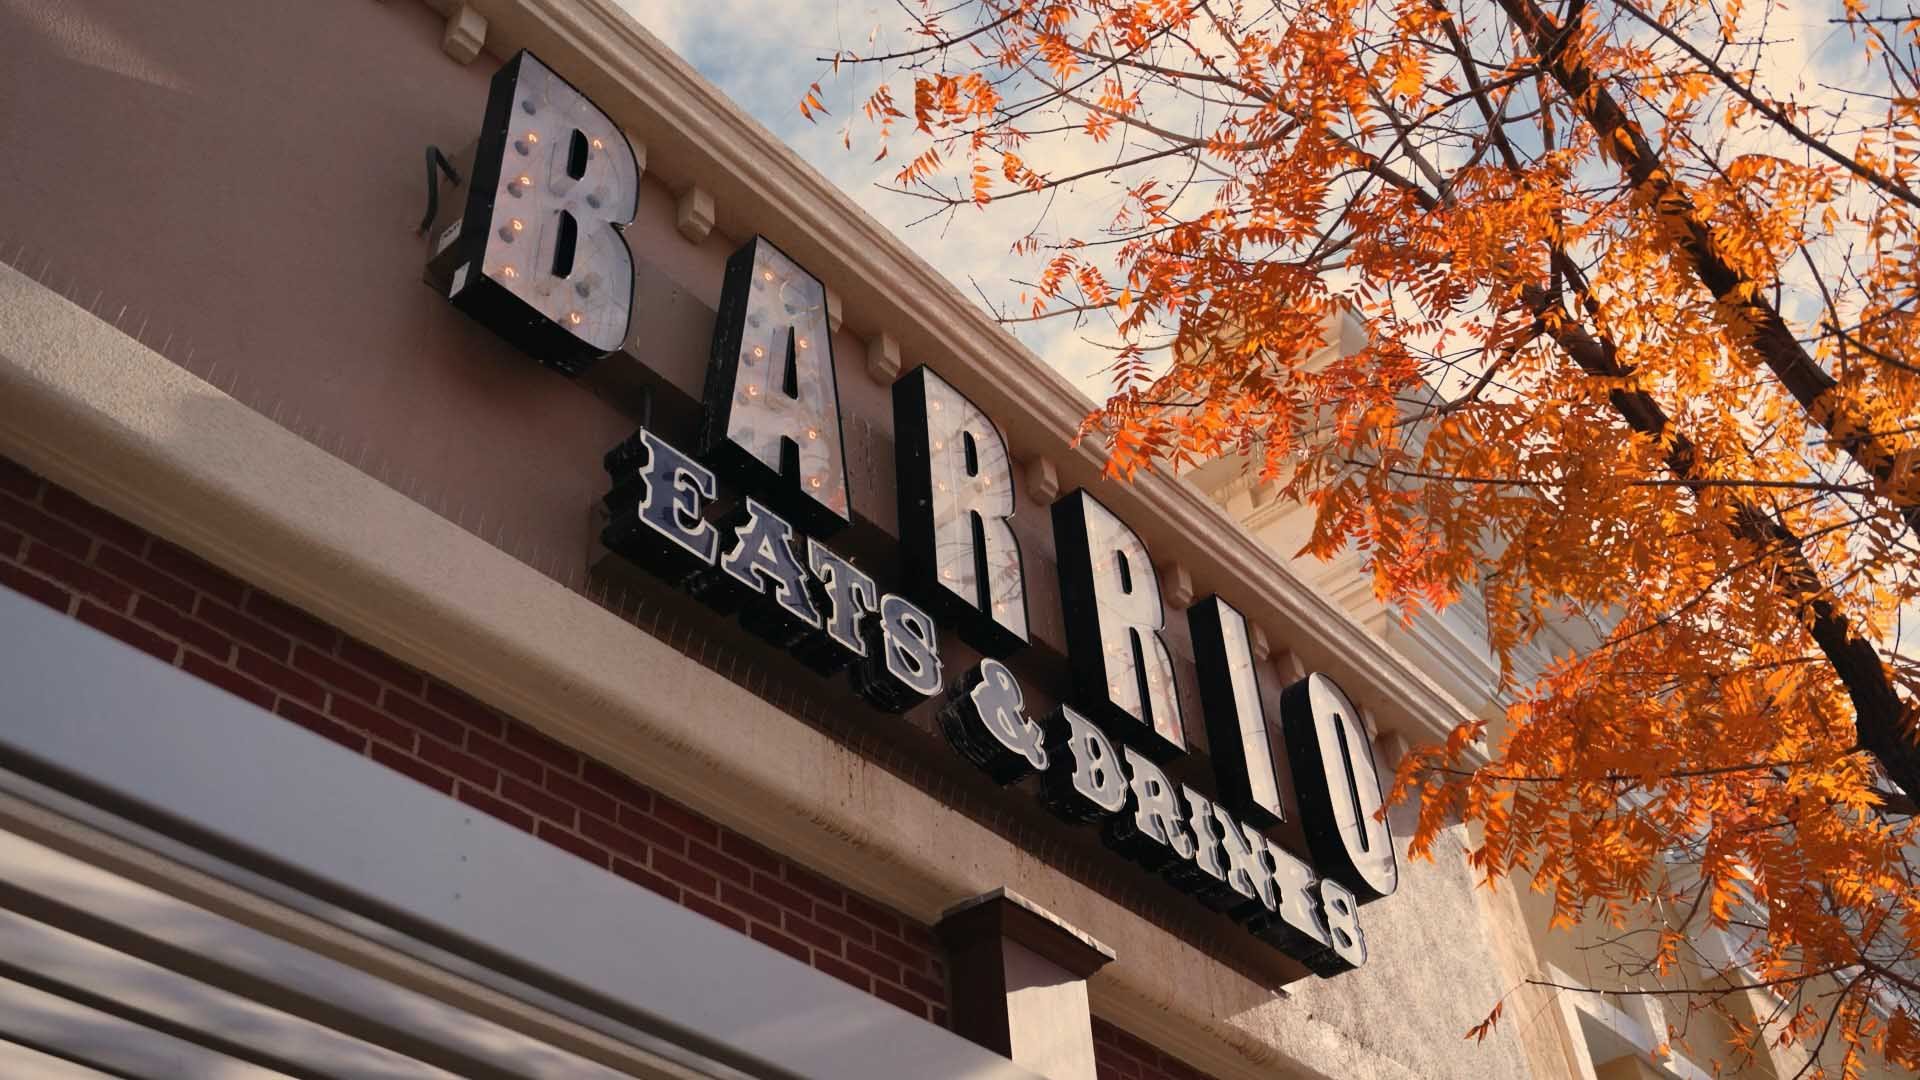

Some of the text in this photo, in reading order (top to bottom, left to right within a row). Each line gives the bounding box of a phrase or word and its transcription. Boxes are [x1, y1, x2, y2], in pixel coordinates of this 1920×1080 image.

[481, 48, 1398, 896] BARRIO
[638, 426, 1367, 967] EATS & DRINKS
